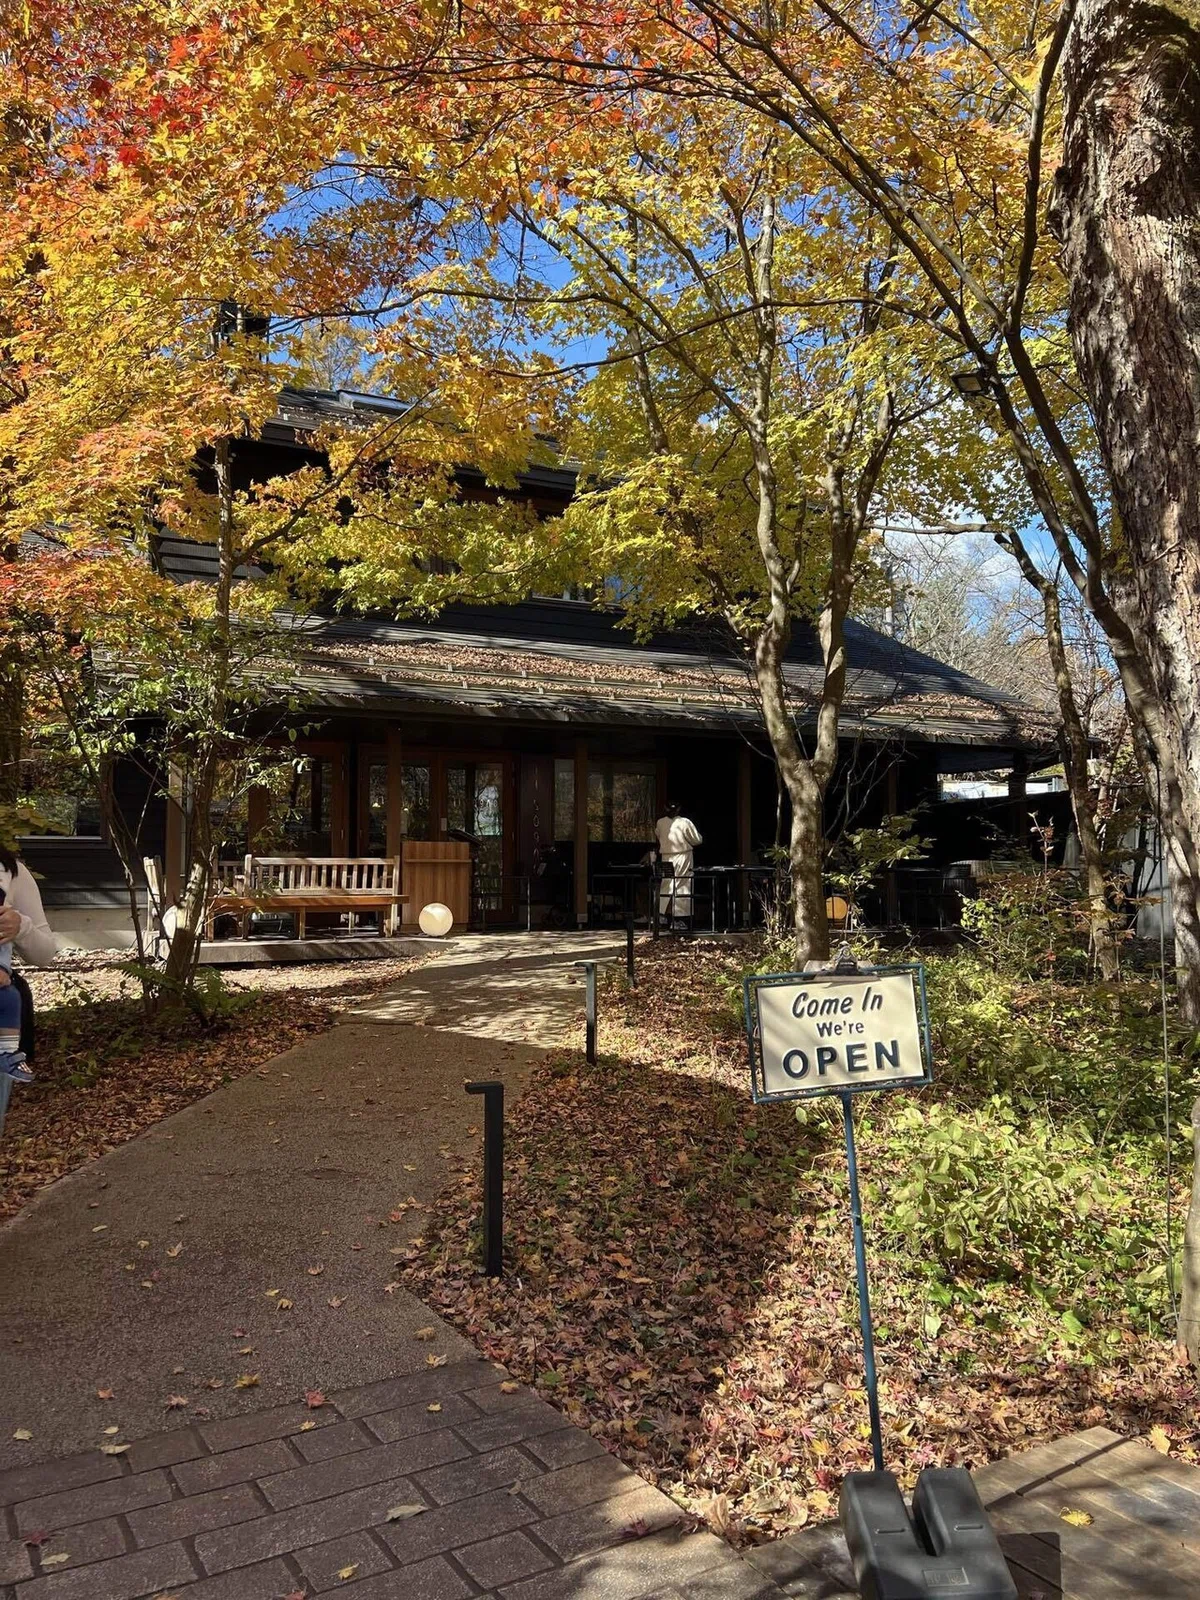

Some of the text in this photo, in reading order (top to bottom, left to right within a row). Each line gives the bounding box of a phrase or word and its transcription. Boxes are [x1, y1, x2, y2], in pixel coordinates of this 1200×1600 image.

[792, 986, 883, 1018] Come In
[816, 1021, 865, 1038] We're
[782, 1039, 901, 1079] OPEN
